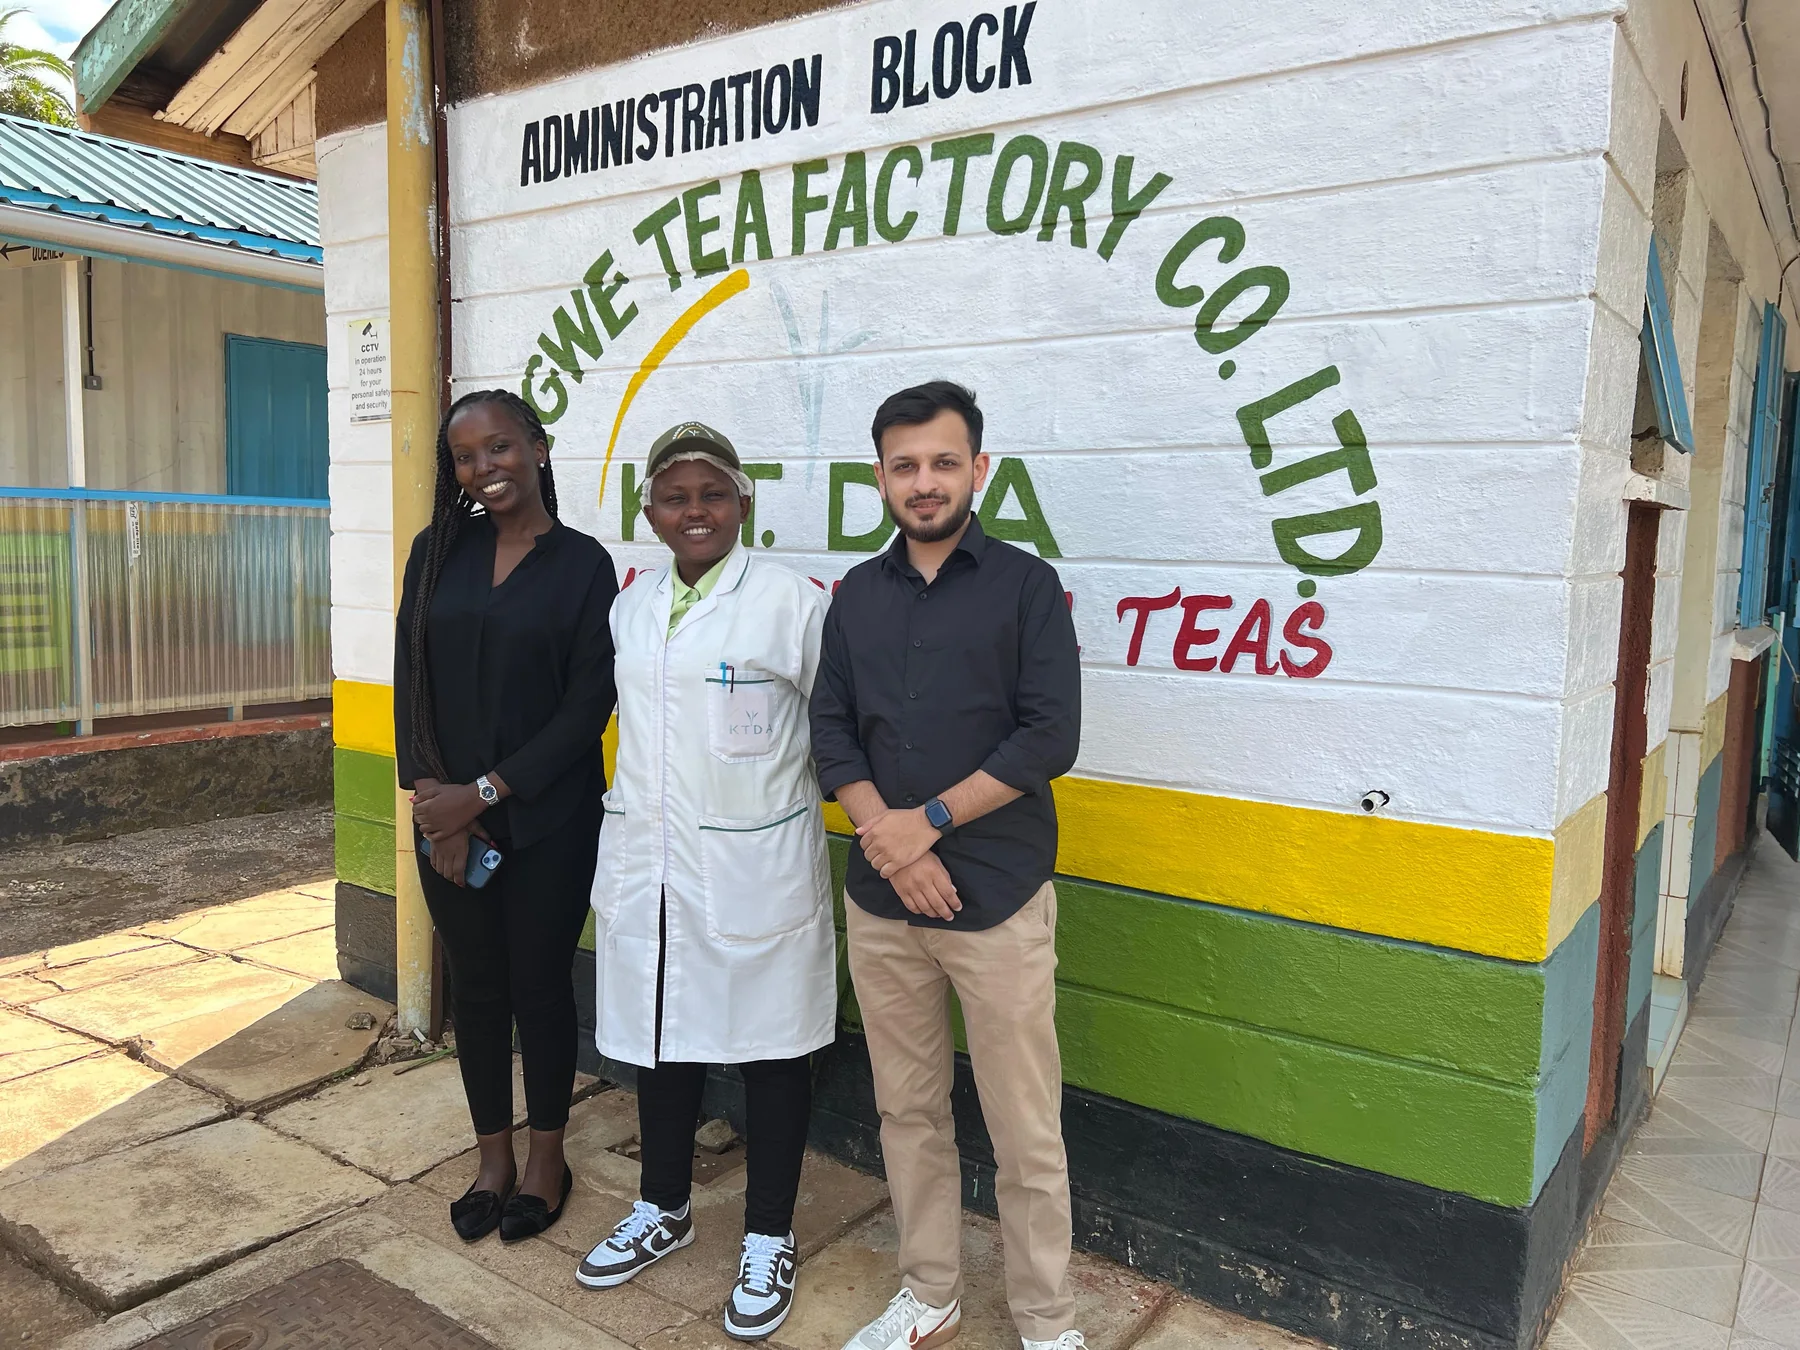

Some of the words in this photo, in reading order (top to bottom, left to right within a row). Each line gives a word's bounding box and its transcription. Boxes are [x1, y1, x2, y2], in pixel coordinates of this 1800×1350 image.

[520, 54, 823, 187] ADMINISTRATION
[870, 1, 1037, 114] BLOCK
[361, 343, 379, 353] CCTV
[361, 355, 386, 365] operation
[522, 249, 638, 452] GWE
[633, 169, 774, 291] TEA
[792, 133, 1174, 262] FACTORY
[1155, 216, 1290, 380] CO.
[1236, 365, 1383, 597] LTD.
[367, 367, 382, 376] hours
[369, 379, 381, 388] your
[352, 390, 374, 401] personal
[375, 388, 391, 398] safety
[356, 402, 366, 410] and
[366, 400, 387, 410] security
[1116, 586, 1333, 679] TEAS
[729, 724, 773, 735] KTDA
